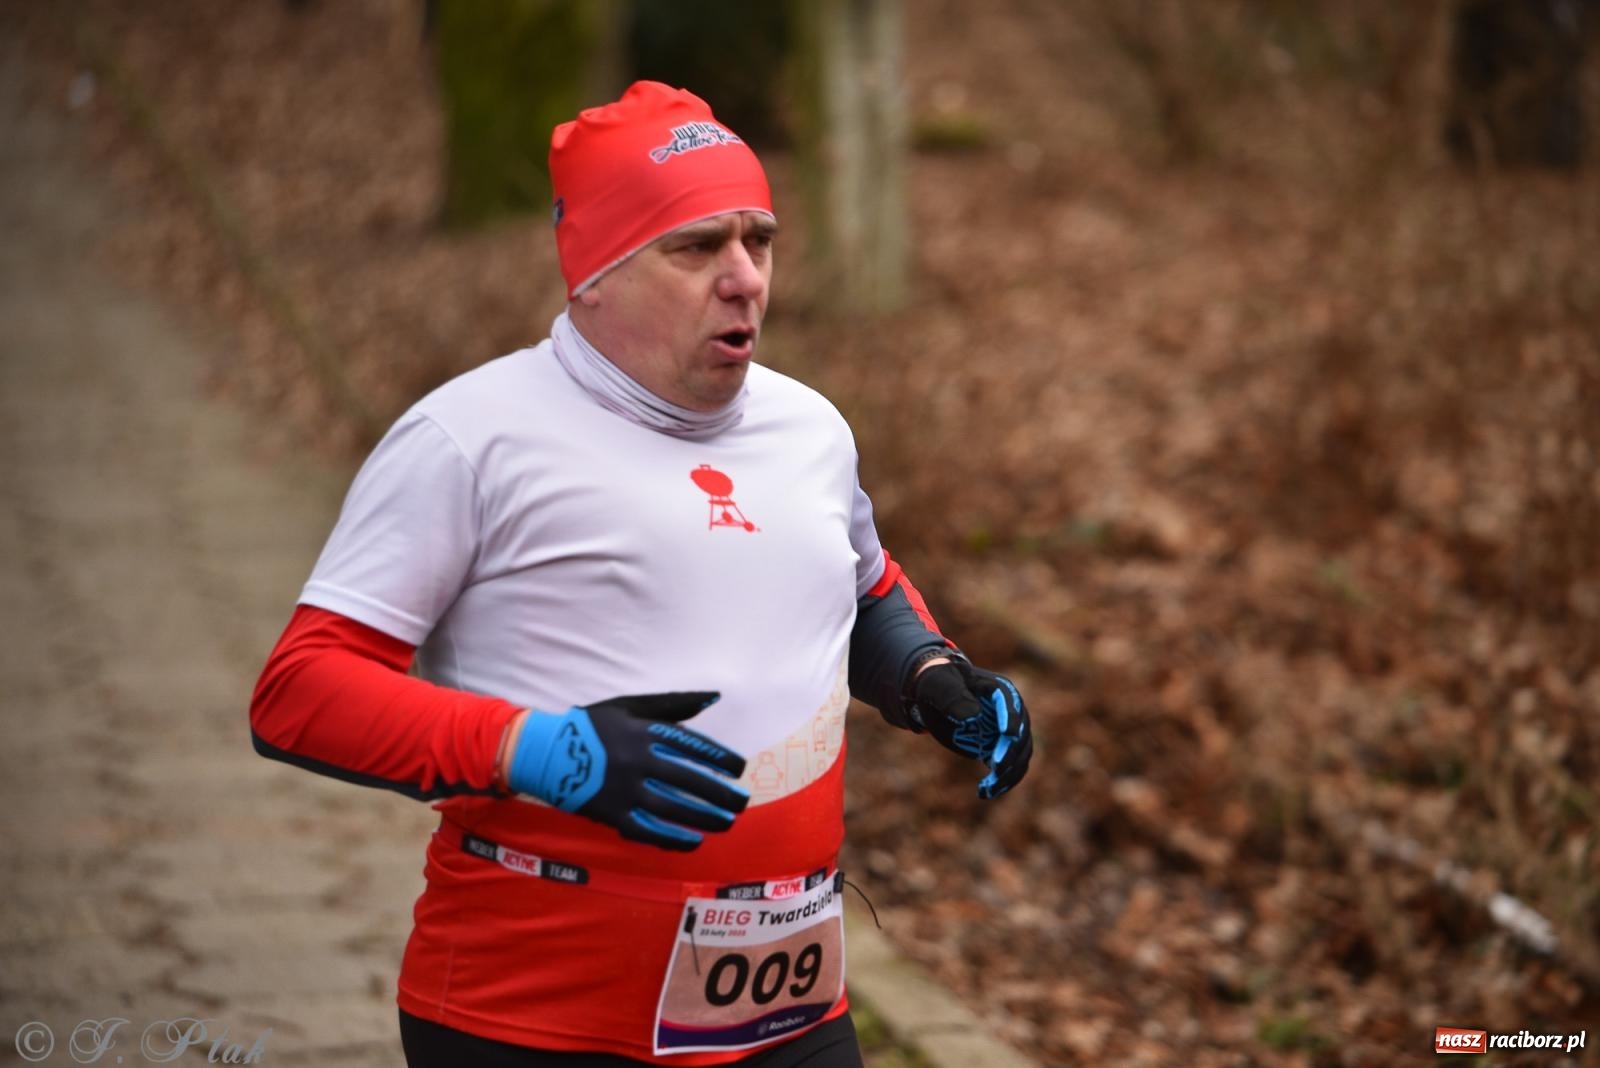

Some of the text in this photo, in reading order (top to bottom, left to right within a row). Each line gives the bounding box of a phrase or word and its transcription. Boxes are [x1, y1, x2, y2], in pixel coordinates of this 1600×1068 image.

[503, 852, 537, 873] ACTIVE
[550, 864, 578, 882] TEAM
[728, 885, 761, 899] WEBER
[703, 909, 752, 925] BIEG
[704, 943, 823, 1006] 009
